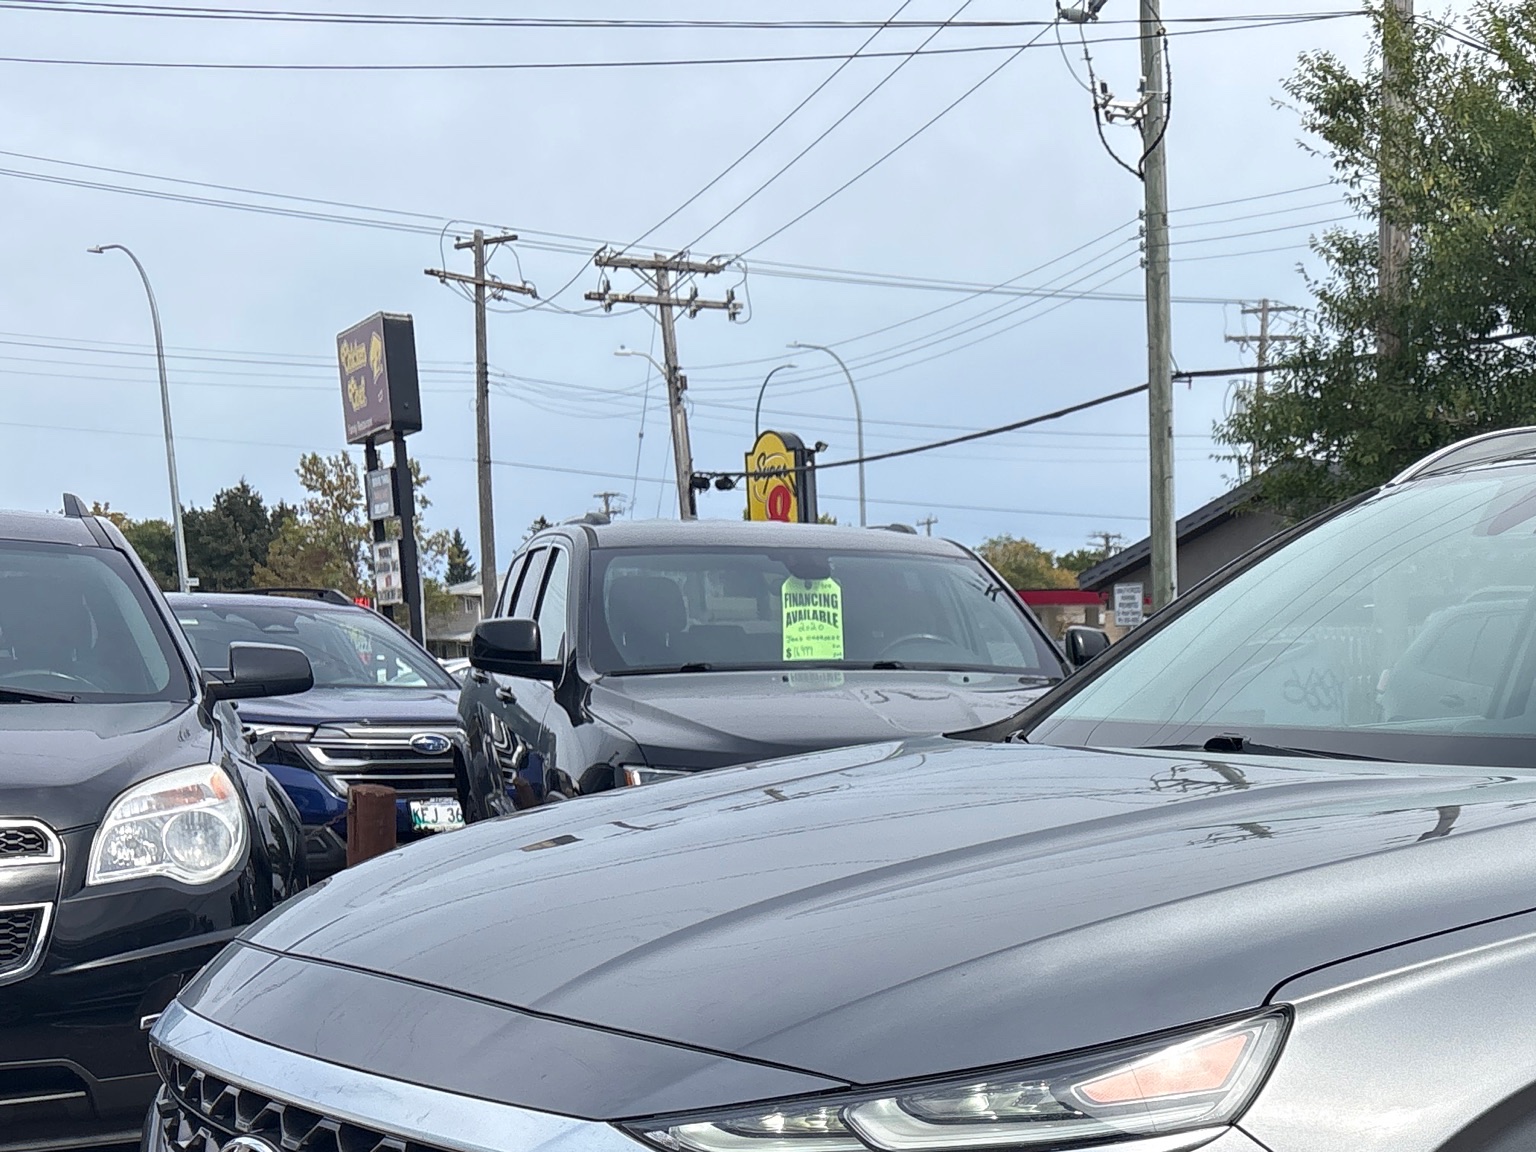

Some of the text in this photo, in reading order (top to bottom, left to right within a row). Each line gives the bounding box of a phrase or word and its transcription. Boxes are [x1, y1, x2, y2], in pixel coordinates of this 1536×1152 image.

[784, 593, 838, 609] FINANCING
[786, 609, 839, 629] AVAILABLE
[413, 807, 438, 825] KEJ
